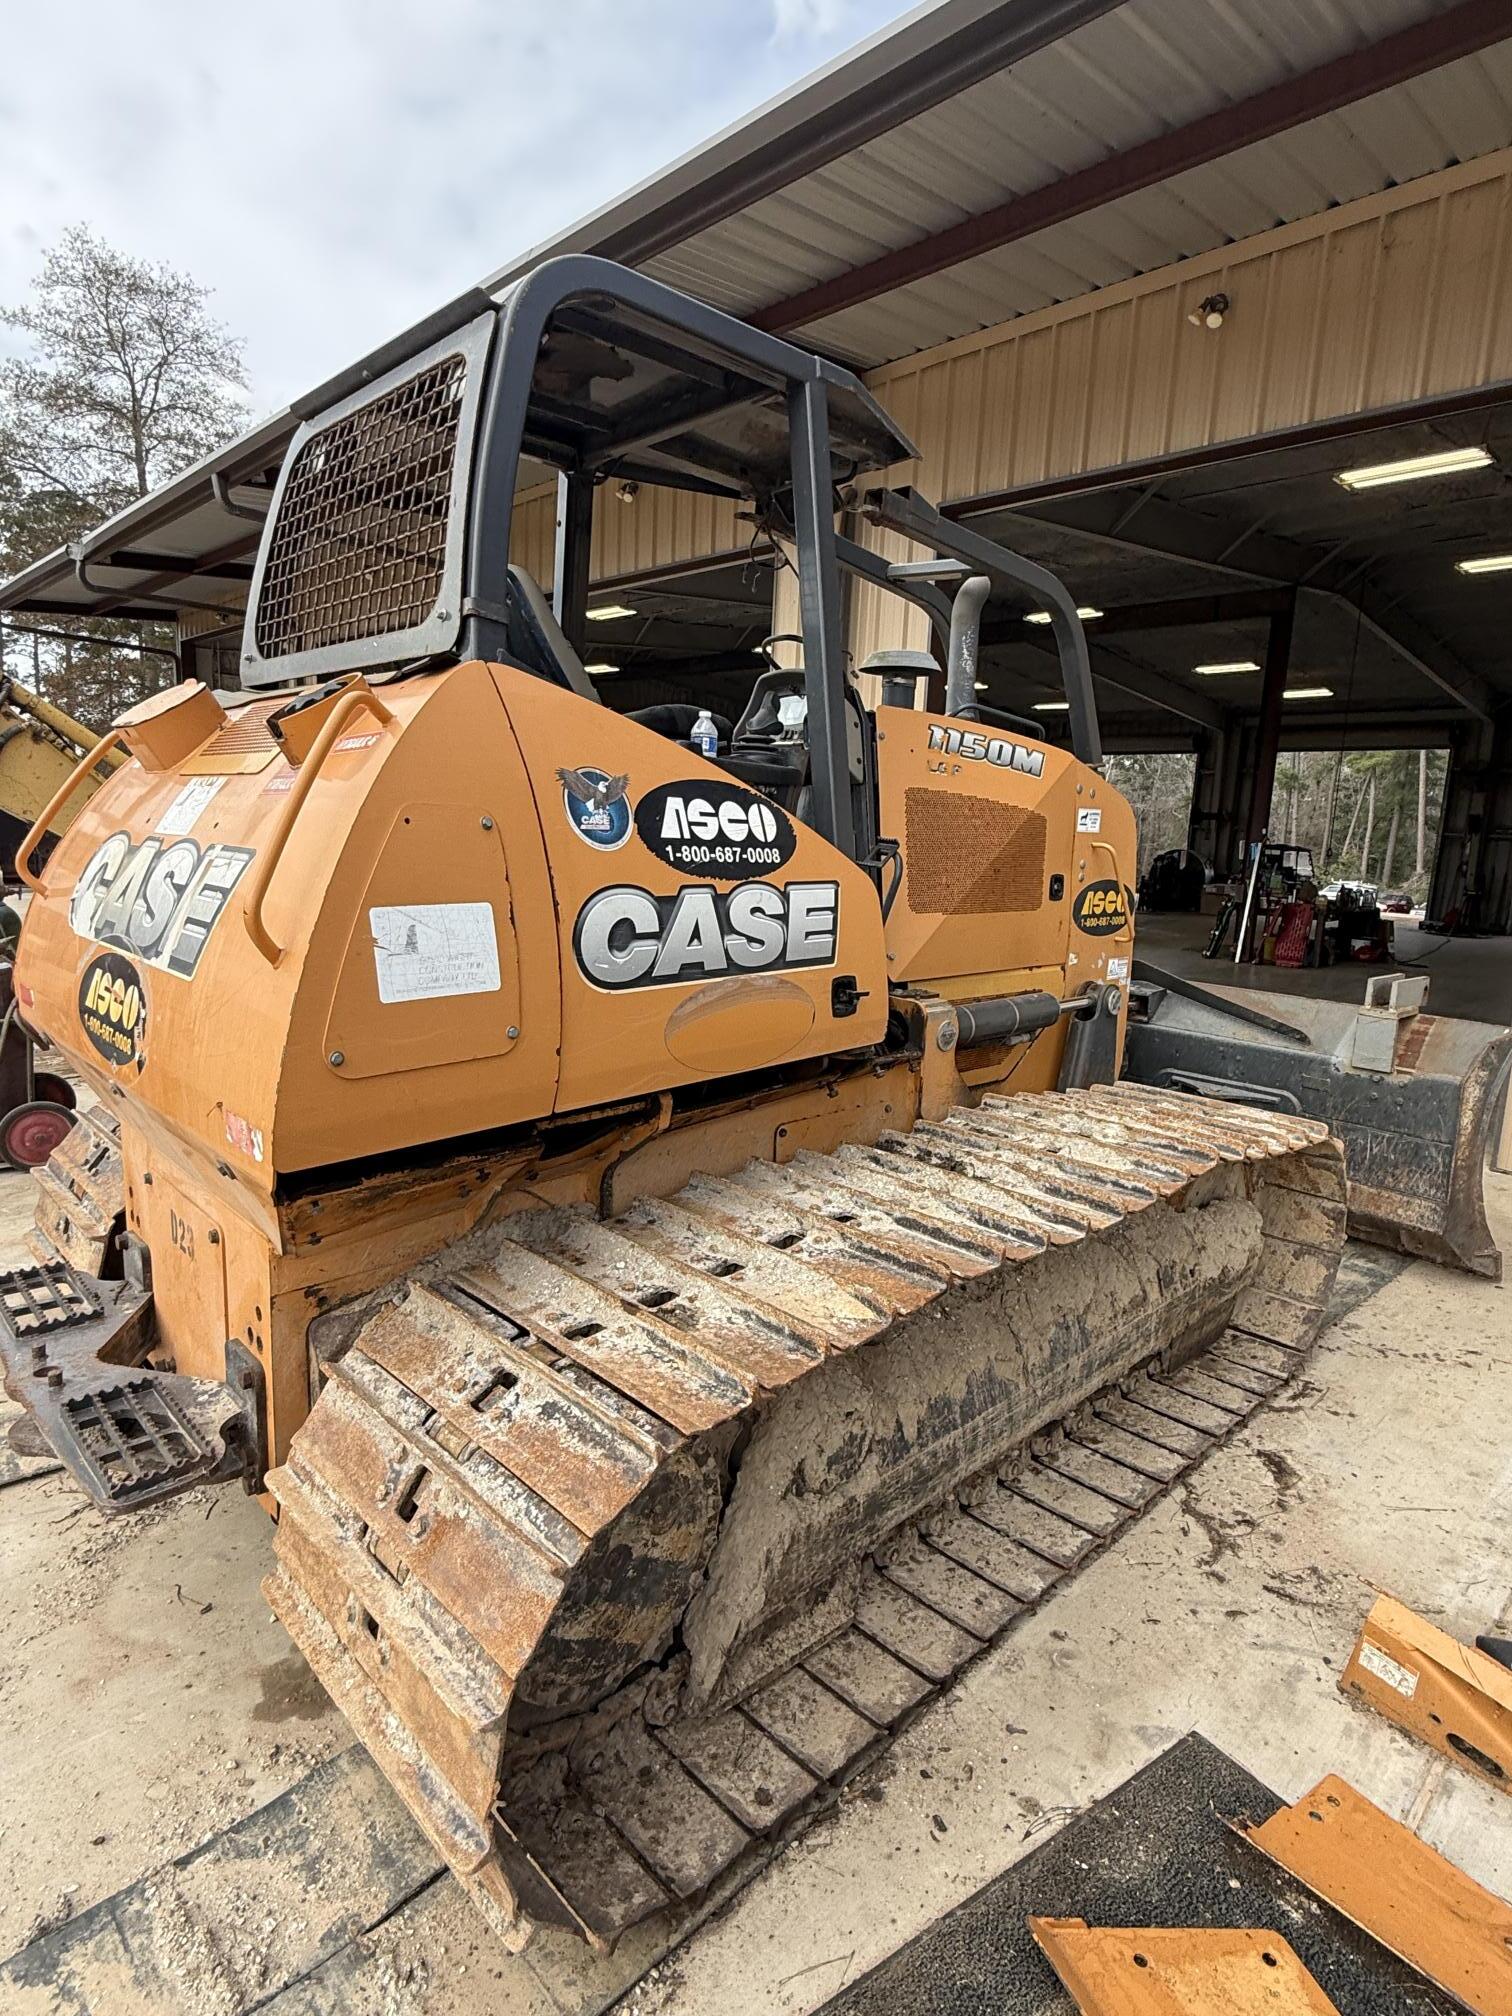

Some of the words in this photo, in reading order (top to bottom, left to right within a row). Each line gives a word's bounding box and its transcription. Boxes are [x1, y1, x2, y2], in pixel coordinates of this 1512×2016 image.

[928, 724, 1046, 778] 1150M
[660, 796, 778, 843] ASCO
[665, 844, 781, 864] 1-800-687-0008
[71, 834, 252, 966] CASE
[577, 883, 838, 984] CASE
[85, 968, 139, 1030] ASCO
